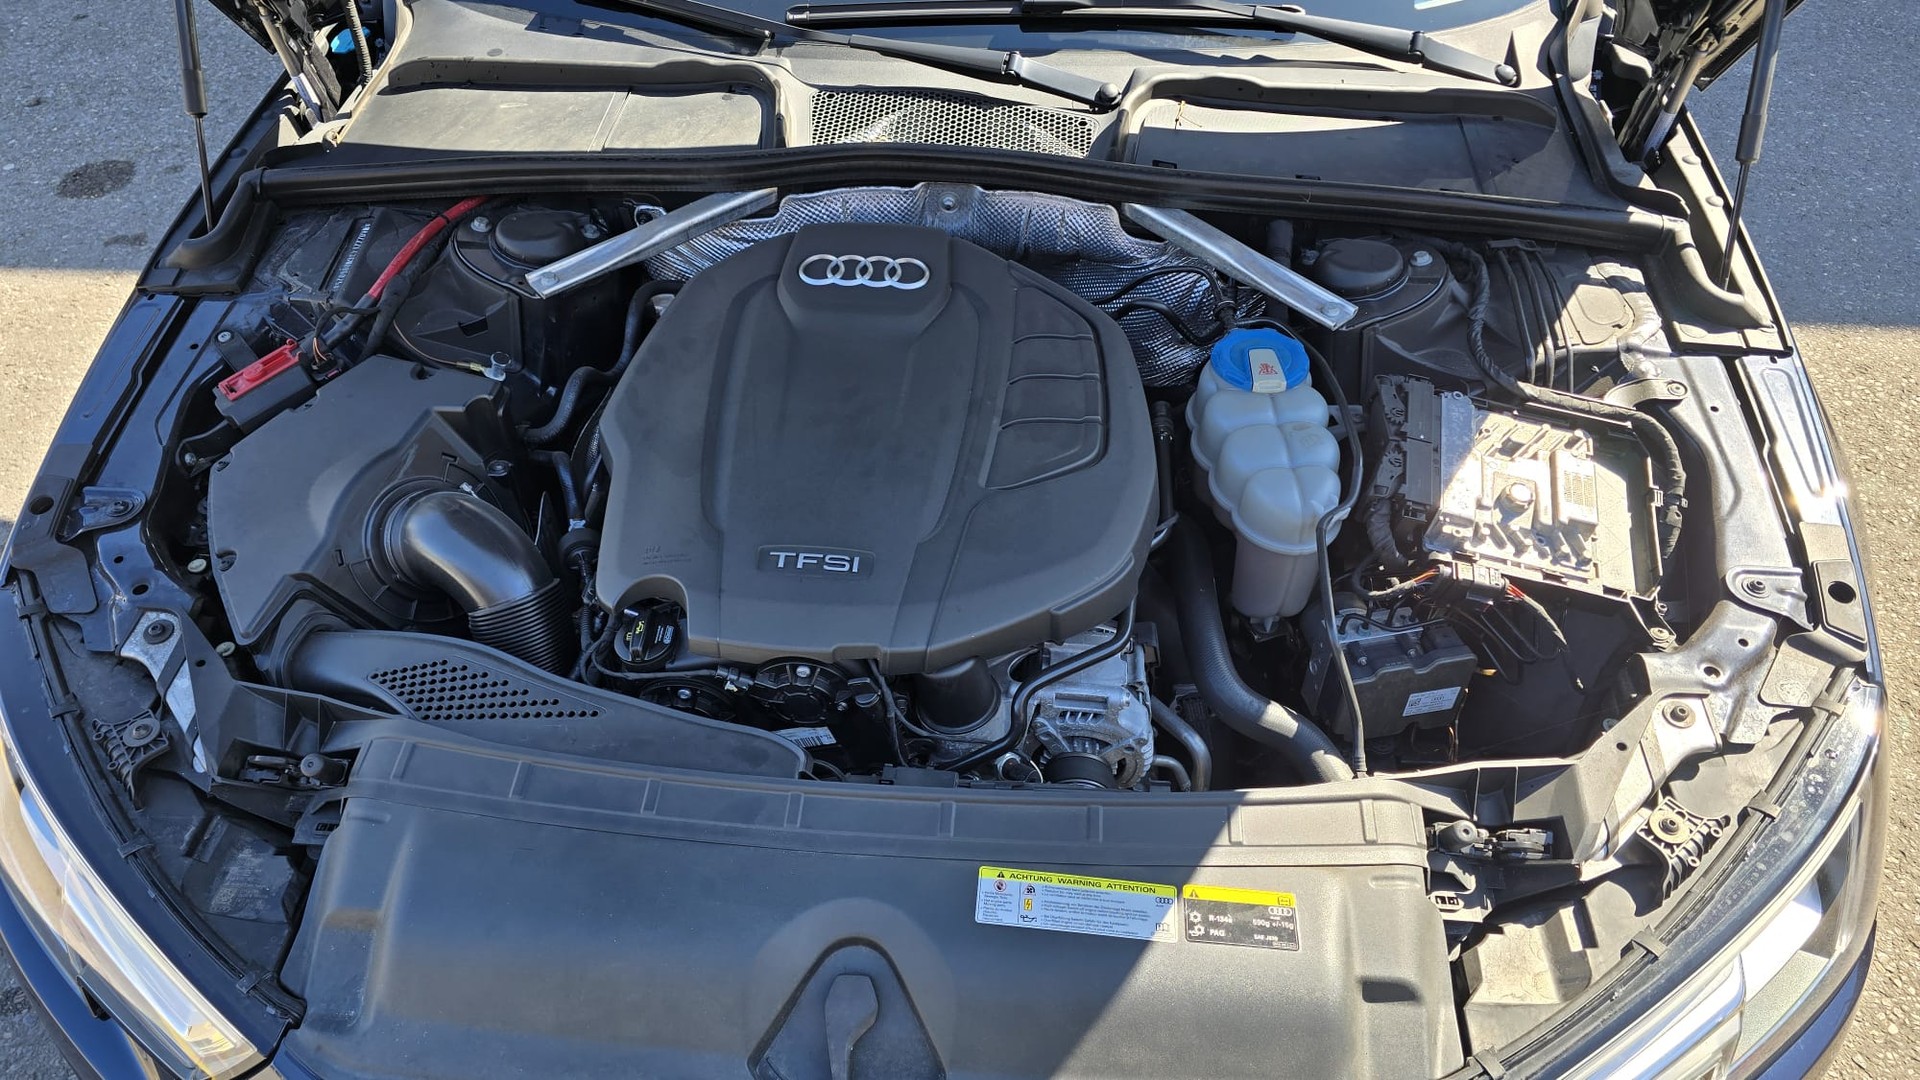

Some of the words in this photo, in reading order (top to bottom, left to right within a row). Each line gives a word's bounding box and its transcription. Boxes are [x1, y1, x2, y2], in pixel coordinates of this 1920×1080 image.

[770, 552, 860, 573] TFSI
[1009, 872, 1053, 883] ACHTUNG
[1057, 877, 1102, 888] WARNING
[1106, 882, 1156, 894] ATTENTION
